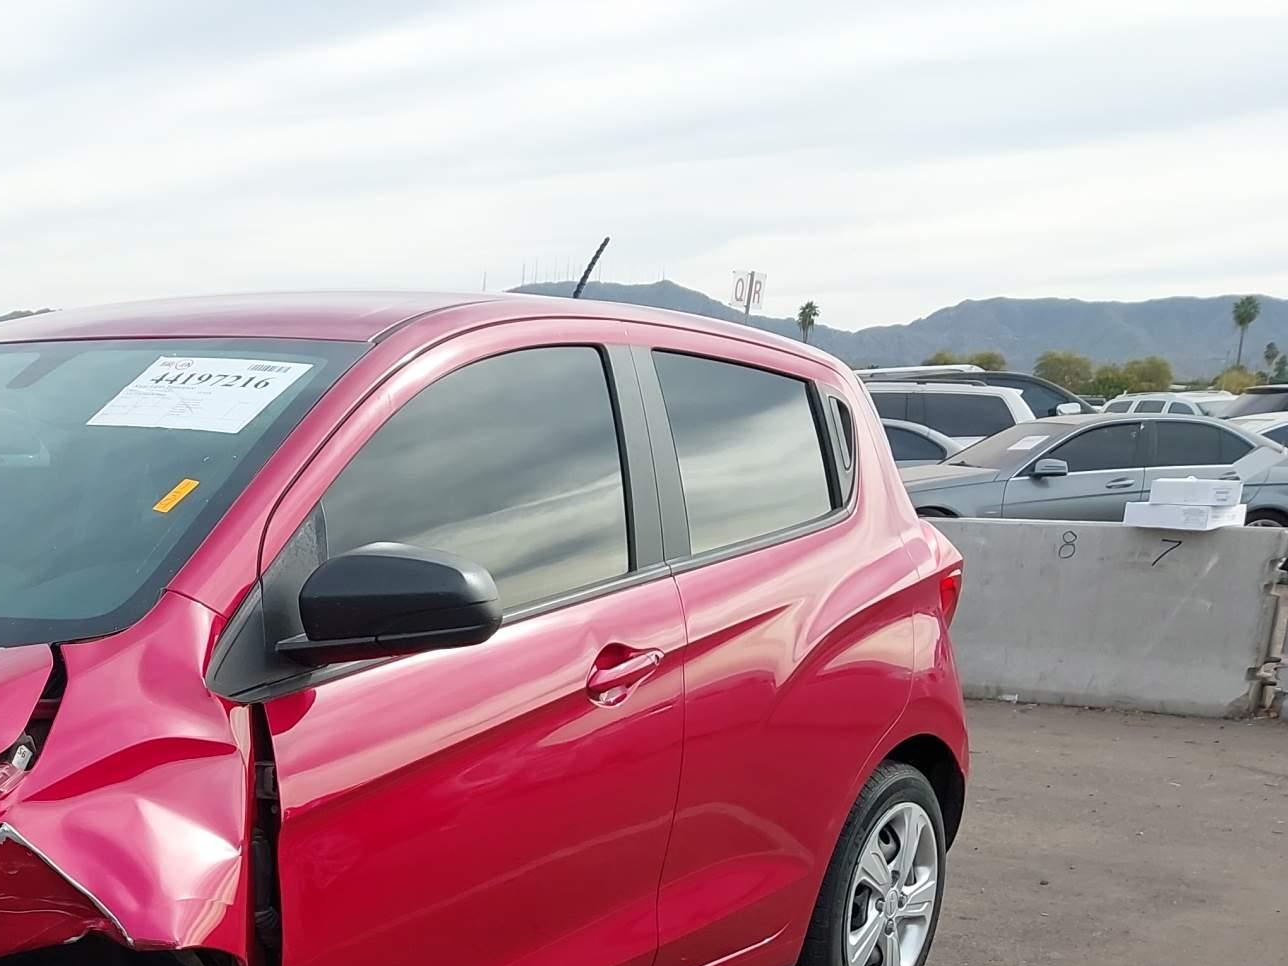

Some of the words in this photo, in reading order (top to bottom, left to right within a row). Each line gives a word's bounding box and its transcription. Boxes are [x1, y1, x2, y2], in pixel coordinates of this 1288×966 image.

[734, 277, 745, 302] Q
[752, 279, 762, 304] R
[151, 371, 274, 390] 44197216
[1058, 530, 1078, 559] 8
[1151, 538, 1183, 567] 7
